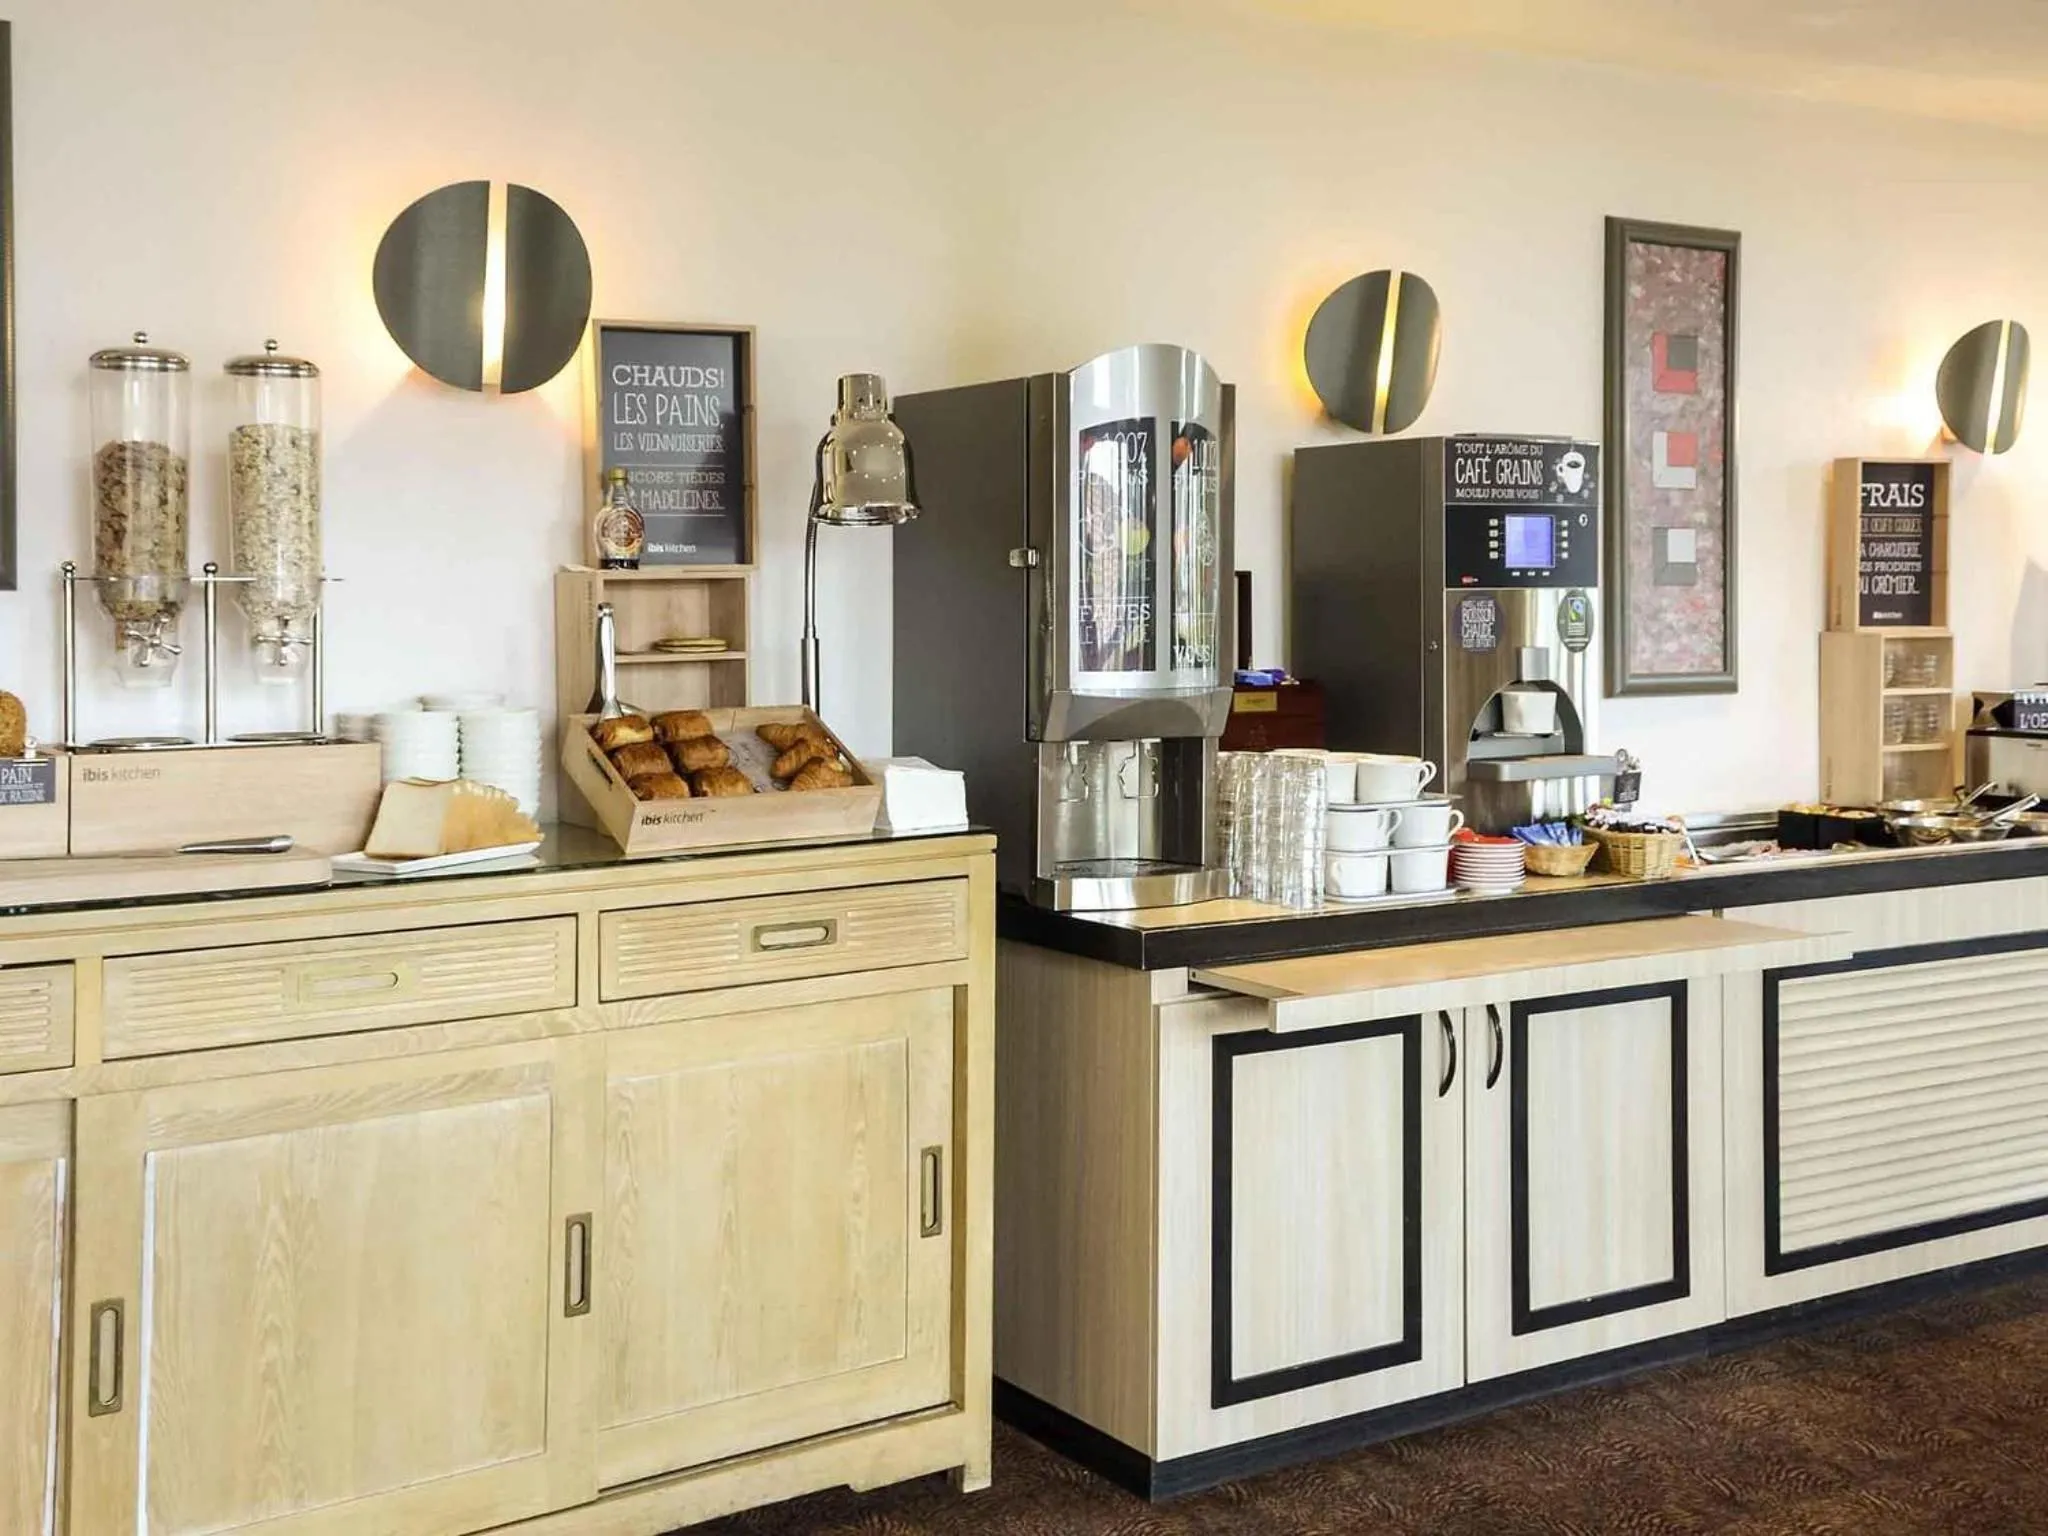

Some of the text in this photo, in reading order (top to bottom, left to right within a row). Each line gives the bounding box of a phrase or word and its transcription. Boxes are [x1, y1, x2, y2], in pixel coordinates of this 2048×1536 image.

[612, 365, 725, 389] CHAUDS!
[613, 392, 725, 430] LES PAINS,
[613, 432, 633, 451] LES
[1455, 442, 1484, 454] TOUT
[1530, 445, 1543, 456] DU
[1455, 455, 1544, 485] CAFÉ GRAINS
[1455, 488, 1489, 499] MOULU
[1491, 488, 1515, 499] POUR
[2, 767, 32, 784] PAIN
[82, 766, 161, 782] ibis kitchen
[641, 810, 704, 826] ibis kitchen
